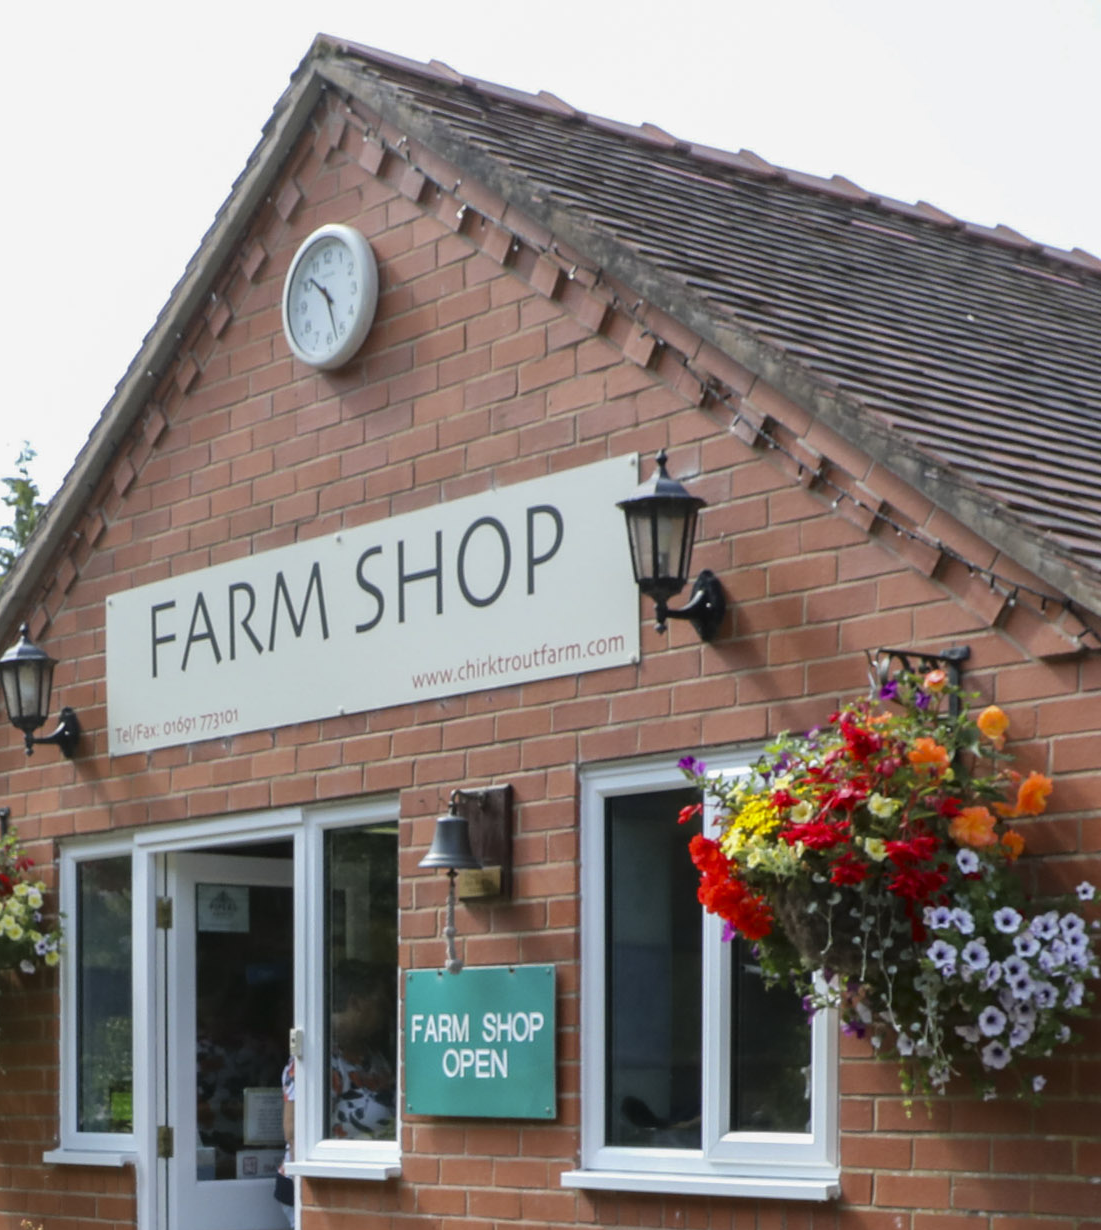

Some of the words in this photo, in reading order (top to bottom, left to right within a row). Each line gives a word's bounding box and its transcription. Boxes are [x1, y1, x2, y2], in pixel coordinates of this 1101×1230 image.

[312, 262, 319, 273] 11
[323, 251, 333, 264] 12
[348, 263, 354, 276] 2
[350, 282, 357, 295] 3
[151, 561, 330, 678] FARM
[355, 504, 564, 634] SHOP
[411, 634, 625, 689] www.chirktroutfarm.com
[115, 723, 160, 746] Tel/Fax:
[163, 717, 196, 736] 01691
[200, 709, 239, 731] 773101
[410, 1013, 470, 1043] FARM
[481, 1011, 545, 1043] SHOP
[442, 1048, 508, 1078] OPEN
